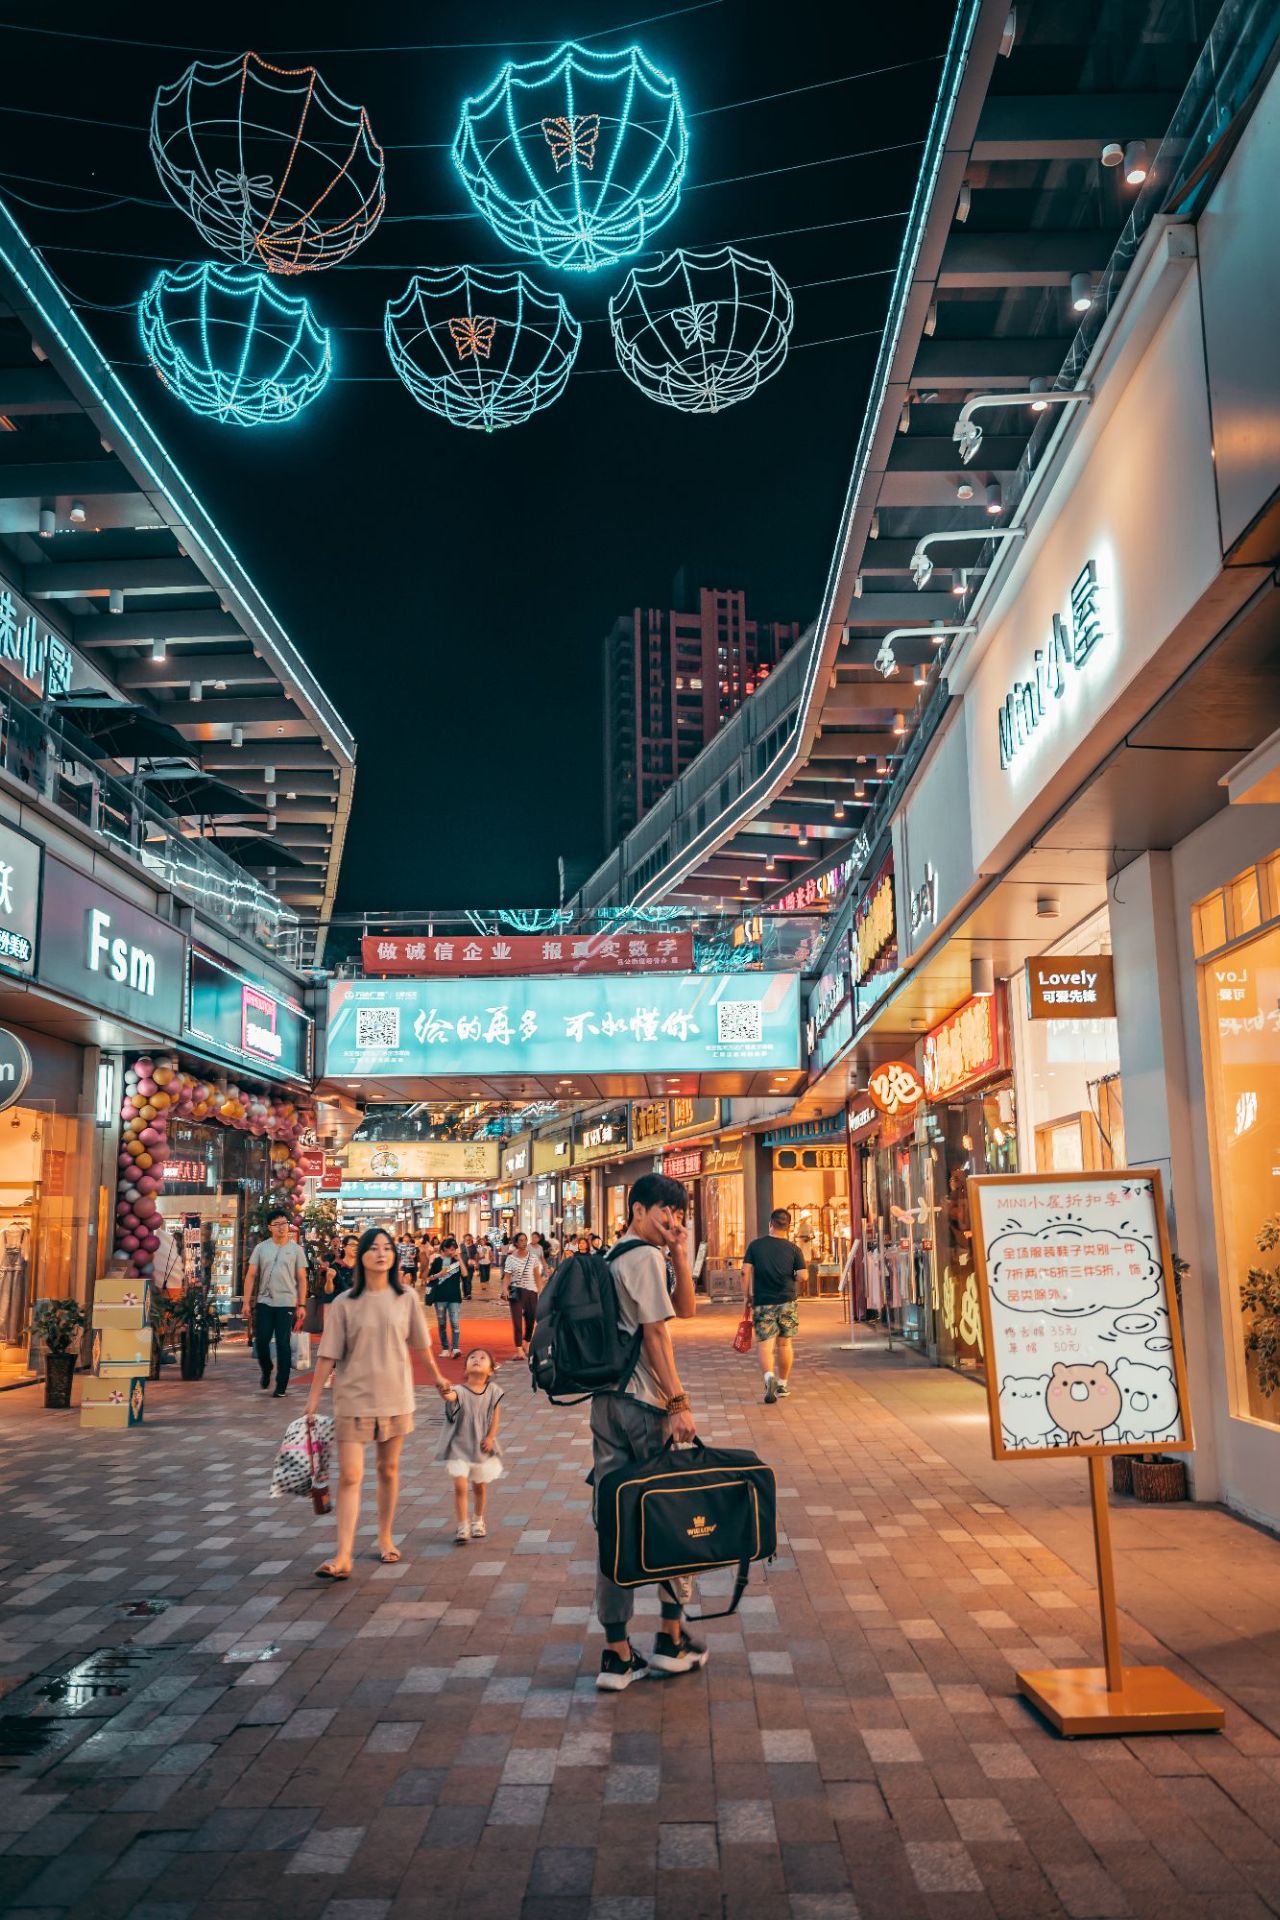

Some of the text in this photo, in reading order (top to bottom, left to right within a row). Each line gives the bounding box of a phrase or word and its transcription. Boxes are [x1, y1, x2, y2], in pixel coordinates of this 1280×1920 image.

[86, 908, 156, 996] Fsm
[376, 939, 678, 961] 做诚信企业 报真实数字
[1038, 969, 1098, 988] Lovely
[413, 1005, 700, 1045] 给的再多 不如懂你
[1003, 1243, 1137, 1259] 全场服装鞋子类别一件
